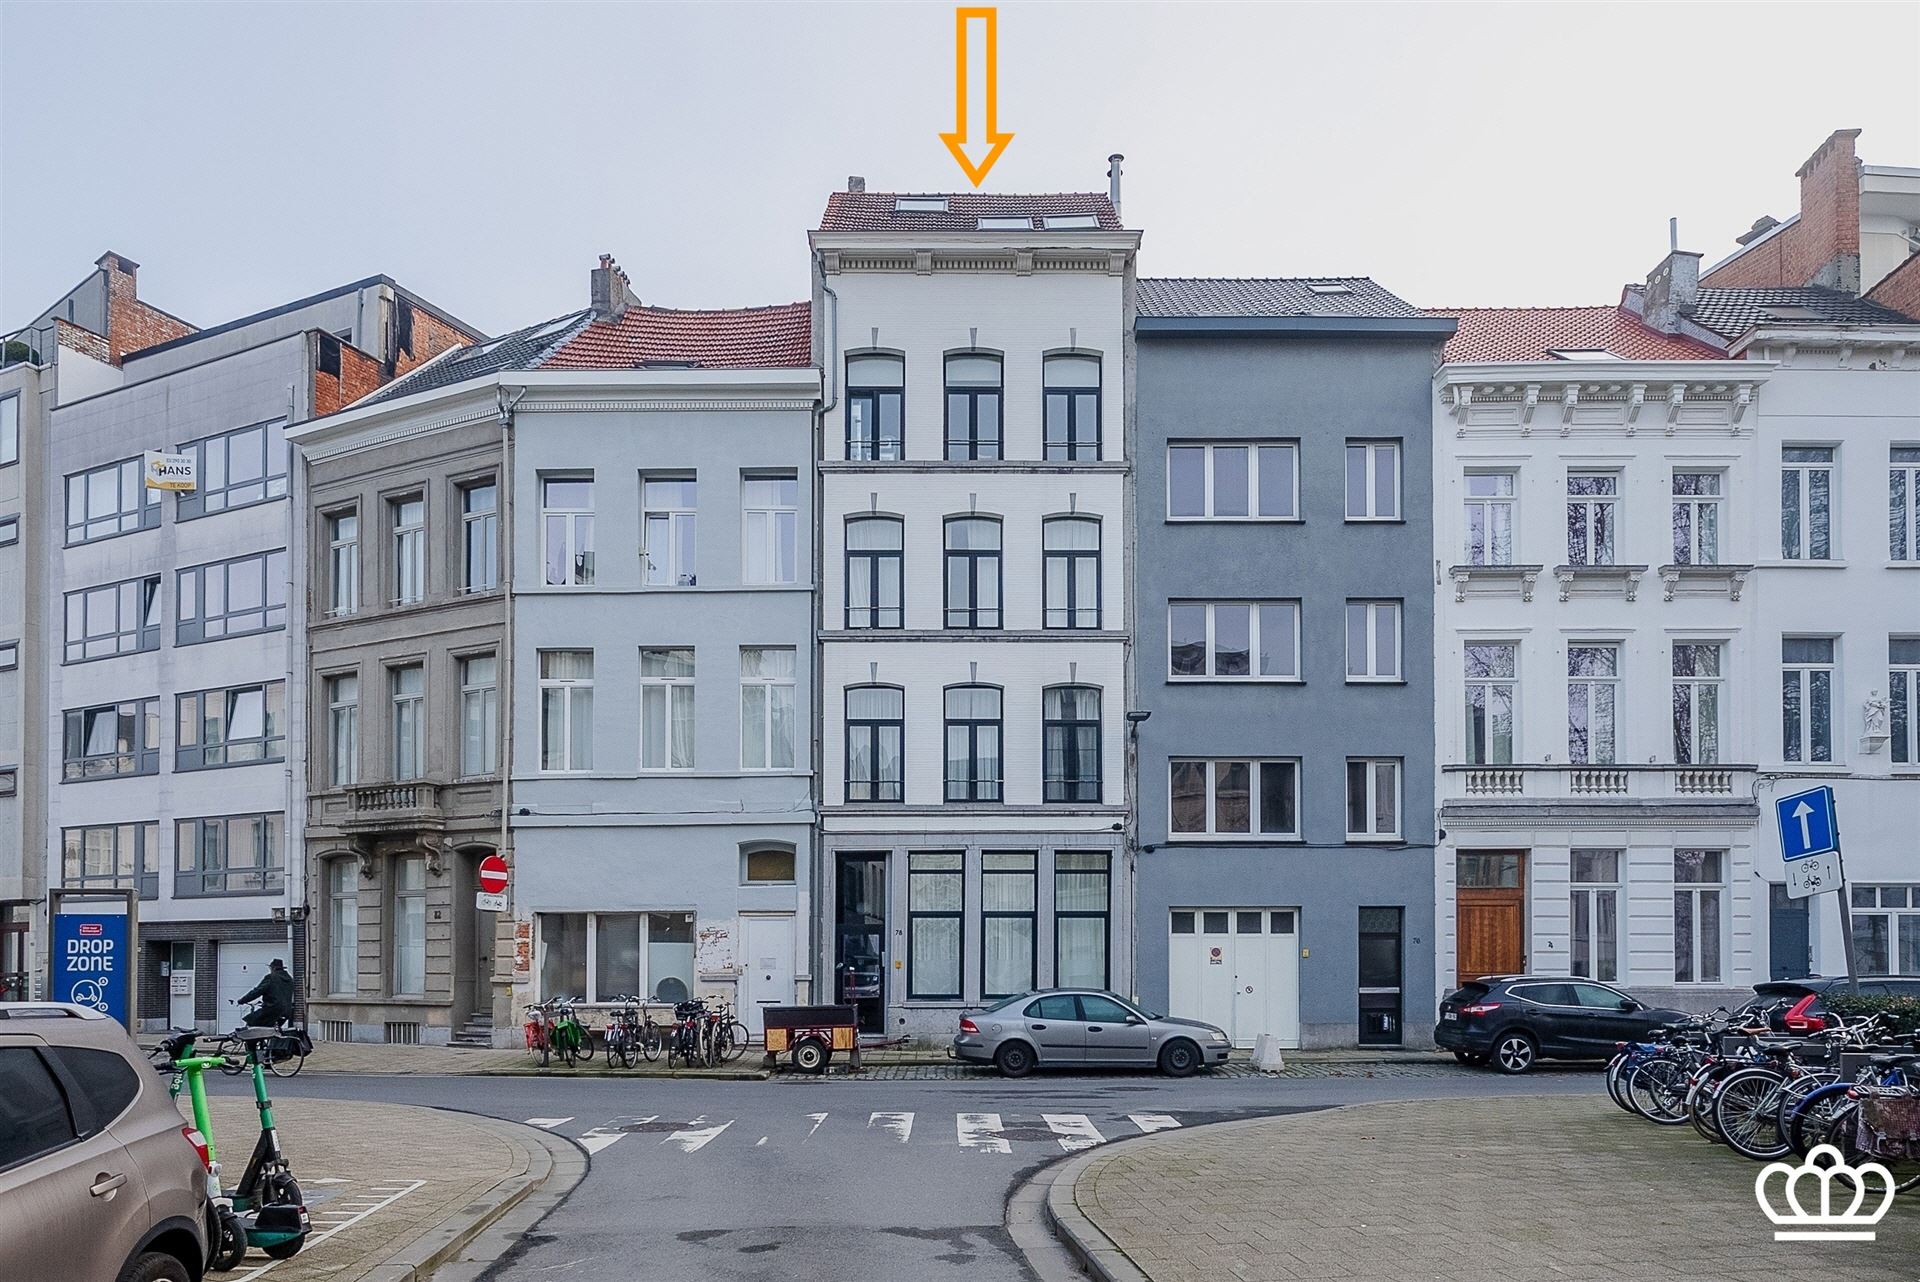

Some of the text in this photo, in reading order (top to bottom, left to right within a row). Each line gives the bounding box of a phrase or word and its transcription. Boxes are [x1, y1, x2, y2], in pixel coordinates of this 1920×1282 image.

[159, 466, 191, 476] HANS
[67, 939, 114, 954] DROP
[66, 956, 114, 971] ZONE
